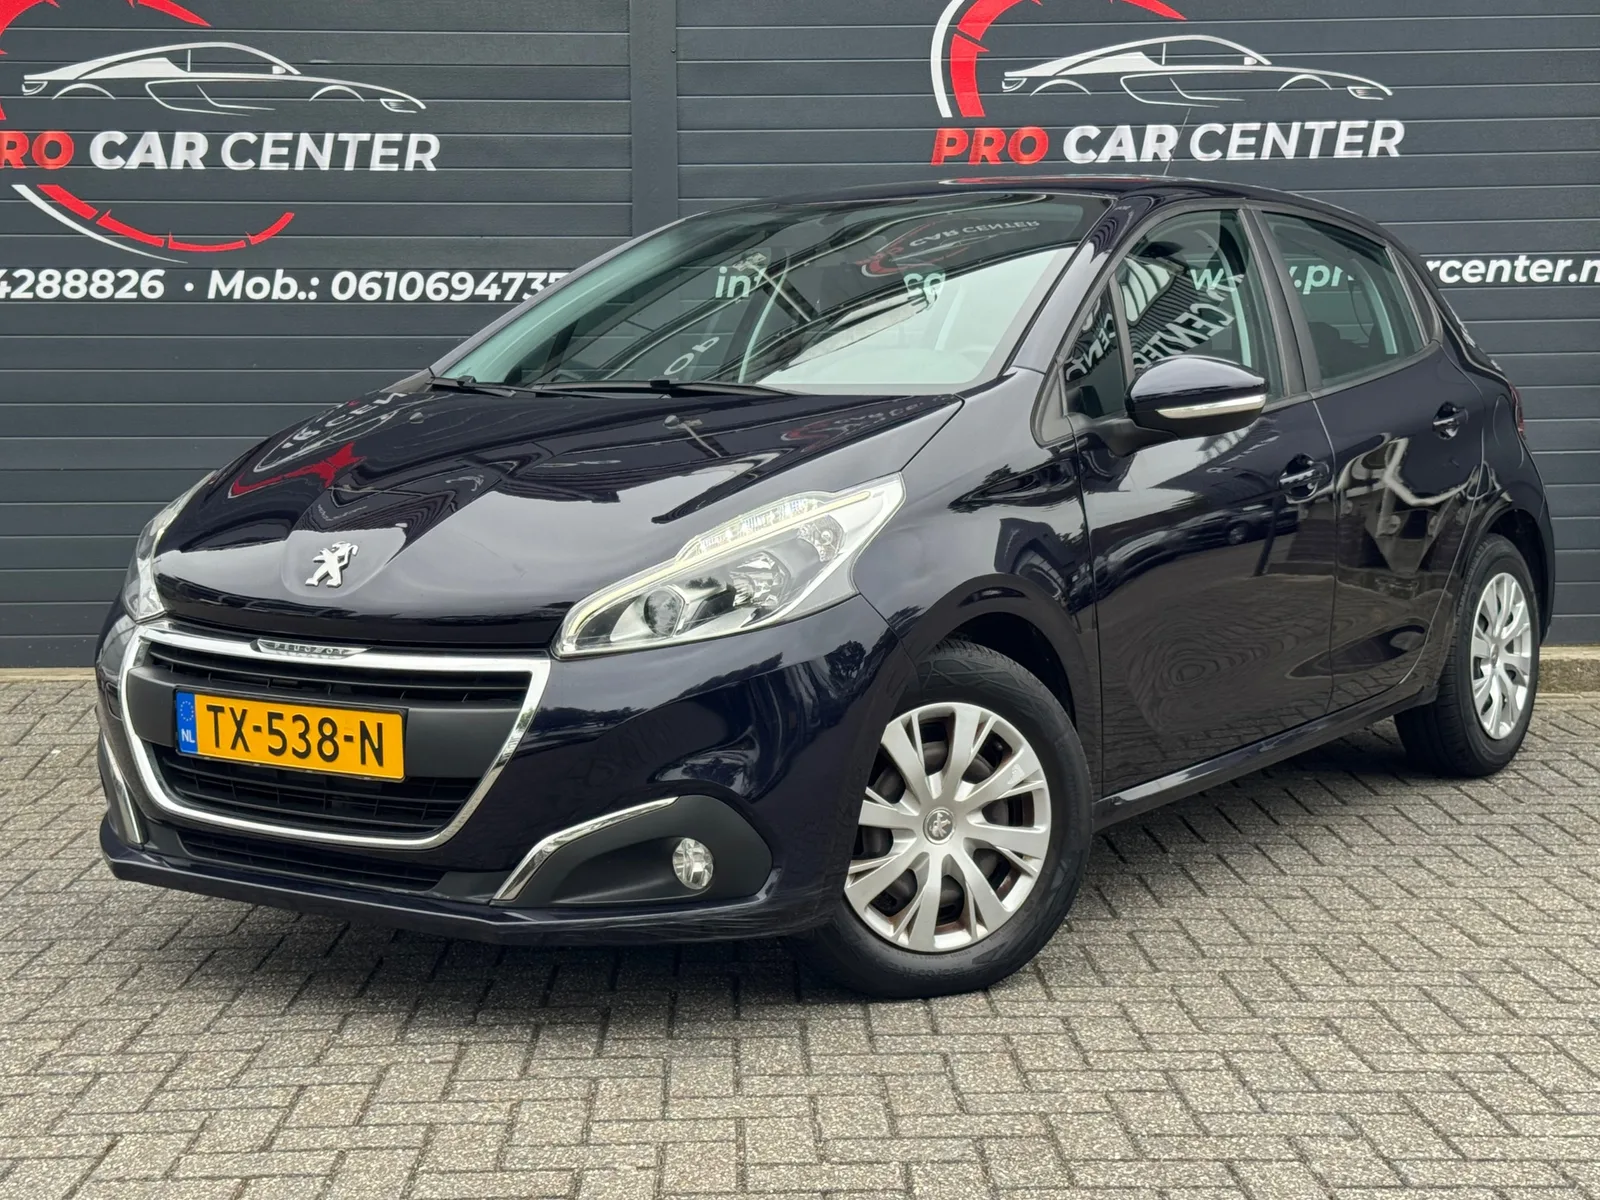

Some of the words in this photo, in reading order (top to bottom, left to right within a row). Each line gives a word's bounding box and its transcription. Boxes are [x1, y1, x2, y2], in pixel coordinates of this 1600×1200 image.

[90, 131, 208, 170] CAR
[220, 132, 441, 172] CENTER
[931, 126, 1049, 165] PRO
[1063, 125, 1176, 164] CAR
[1189, 120, 1406, 161] CENTER
[207, 268, 320, 301] Mob.:
[181, 728, 196, 744] NL
[206, 704, 384, 767] TX-538-N
